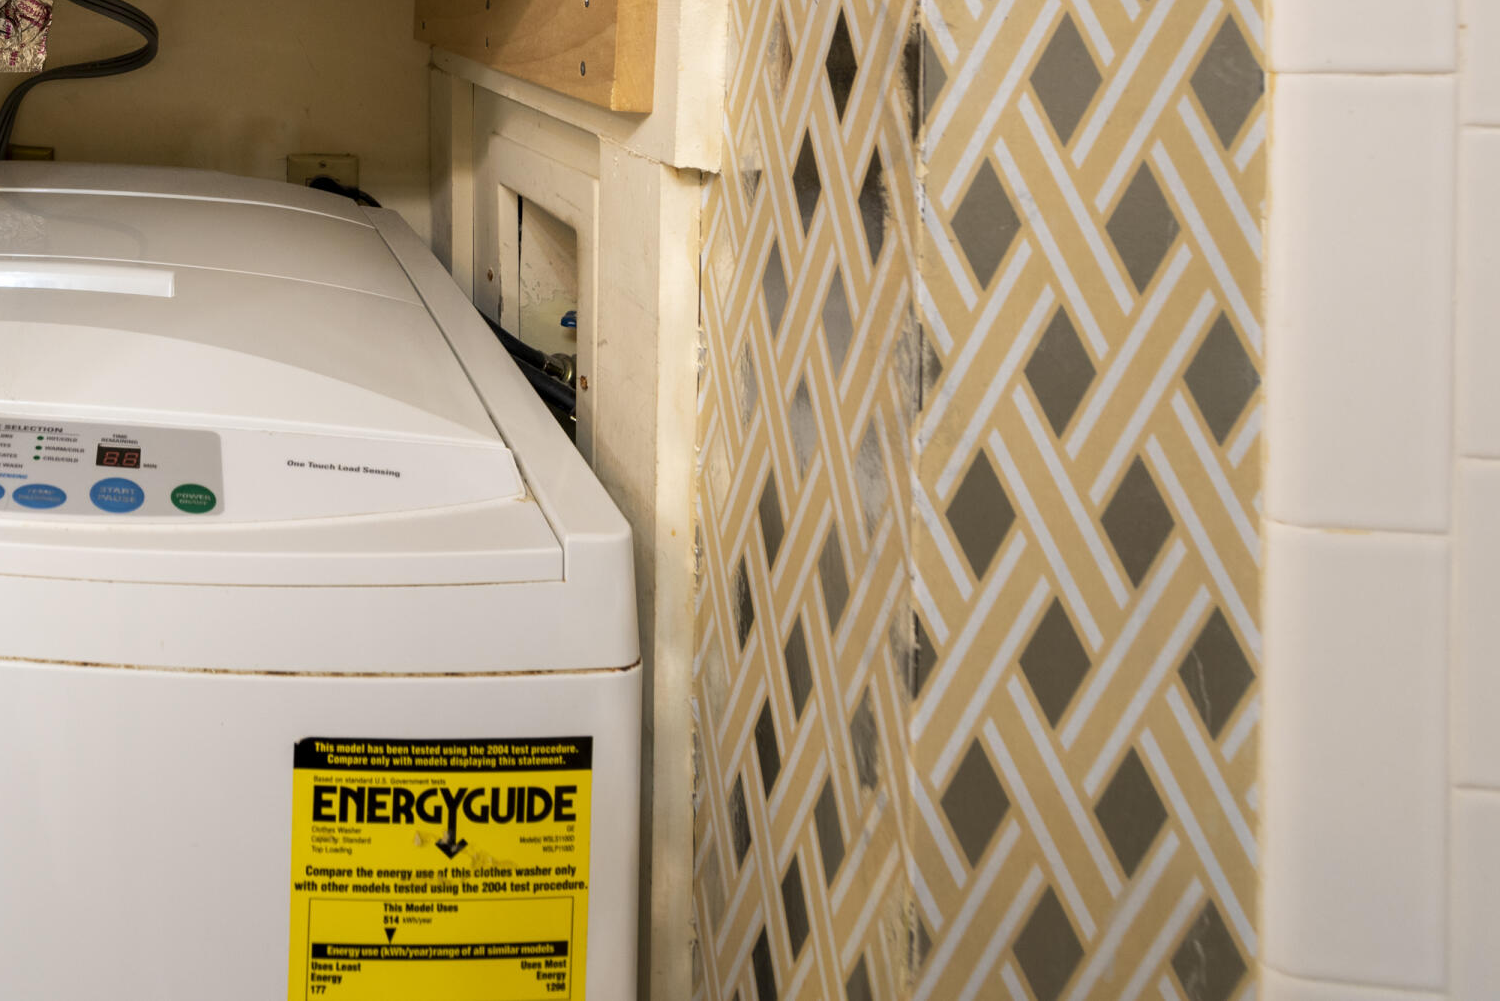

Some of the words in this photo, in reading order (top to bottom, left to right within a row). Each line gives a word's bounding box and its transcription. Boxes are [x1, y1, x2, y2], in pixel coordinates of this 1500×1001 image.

[4, 423, 64, 433] SELECTION
[286, 459, 306, 468] One
[308, 461, 336, 471] Touch
[337, 463, 361, 473] Load
[362, 466, 400, 478] Sensing
[100, 486, 135, 495] START
[98, 494, 136, 504] PAUSE
[176, 492, 211, 502] POWER
[315, 742, 334, 753] This
[336, 743, 366, 754] model
[367, 744, 384, 754] has
[386, 744, 409, 755] been
[411, 745, 441, 755] tested
[442, 745, 468, 757] using
[469, 744, 485, 755] the
[486, 744, 509, 755] 2004
[511, 744, 530, 755] test
[531, 743, 579, 755] procedure.
[327, 754, 368, 766] Compare
[370, 754, 391, 767] only
[392, 755, 413, 766] with
[415, 755, 448, 767] models
[450, 756, 497, 768] displaying
[498, 755, 516, 766] this
[518, 755, 567, 766] statement.
[313, 775, 333, 783] Based
[345, 776, 373, 784] standard
[374, 777, 387, 785] U.S.
[390, 777, 430, 786] Government
[312, 785, 578, 825] ENERGYGUIDE
[311, 825, 335, 833] Clothes
[342, 836, 372, 845] Standard
[311, 845, 324, 854] Top
[325, 846, 353, 855] Loading
[305, 865, 353, 879] Compare
[356, 867, 374, 878] the
[376, 869, 412, 881] energy
[415, 869, 434, 879] use
[437, 867, 448, 878] of
[451, 867, 471, 878] this
[474, 866, 513, 878] clothes
[515, 866, 552, 877] washer
[555, 864, 577, 877] only
[294, 880, 318, 892] with
[321, 881, 349, 893] other
[352, 882, 391, 893] models
[394, 883, 428, 894] tested
[430, 883, 459, 896] using
[462, 882, 479, 893] the
[482, 882, 507, 893] 2004
[510, 881, 530, 892] test
[533, 879, 588, 894] procedure.
[383, 903, 402, 912] This
[405, 903, 434, 912] Model
[436, 903, 459, 913] Uses
[402, 916, 432, 926] kWh/year
[327, 945, 360, 958] Energy
[361, 947, 379, 956] use
[380, 946, 432, 959] (kWh/year)
[433, 947, 460, 959] range
[461, 946, 471, 956] of
[473, 946, 485, 956] all
[487, 945, 520, 956] similar
[521, 944, 555, 955] models
[311, 961, 333, 972] Uses
[336, 962, 361, 972] Least
[520, 960, 542, 970] Uses
[544, 959, 567, 969] Most
[311, 972, 343, 984] Energy
[536, 971, 566, 981] Energy
[311, 985, 326, 995] 177
